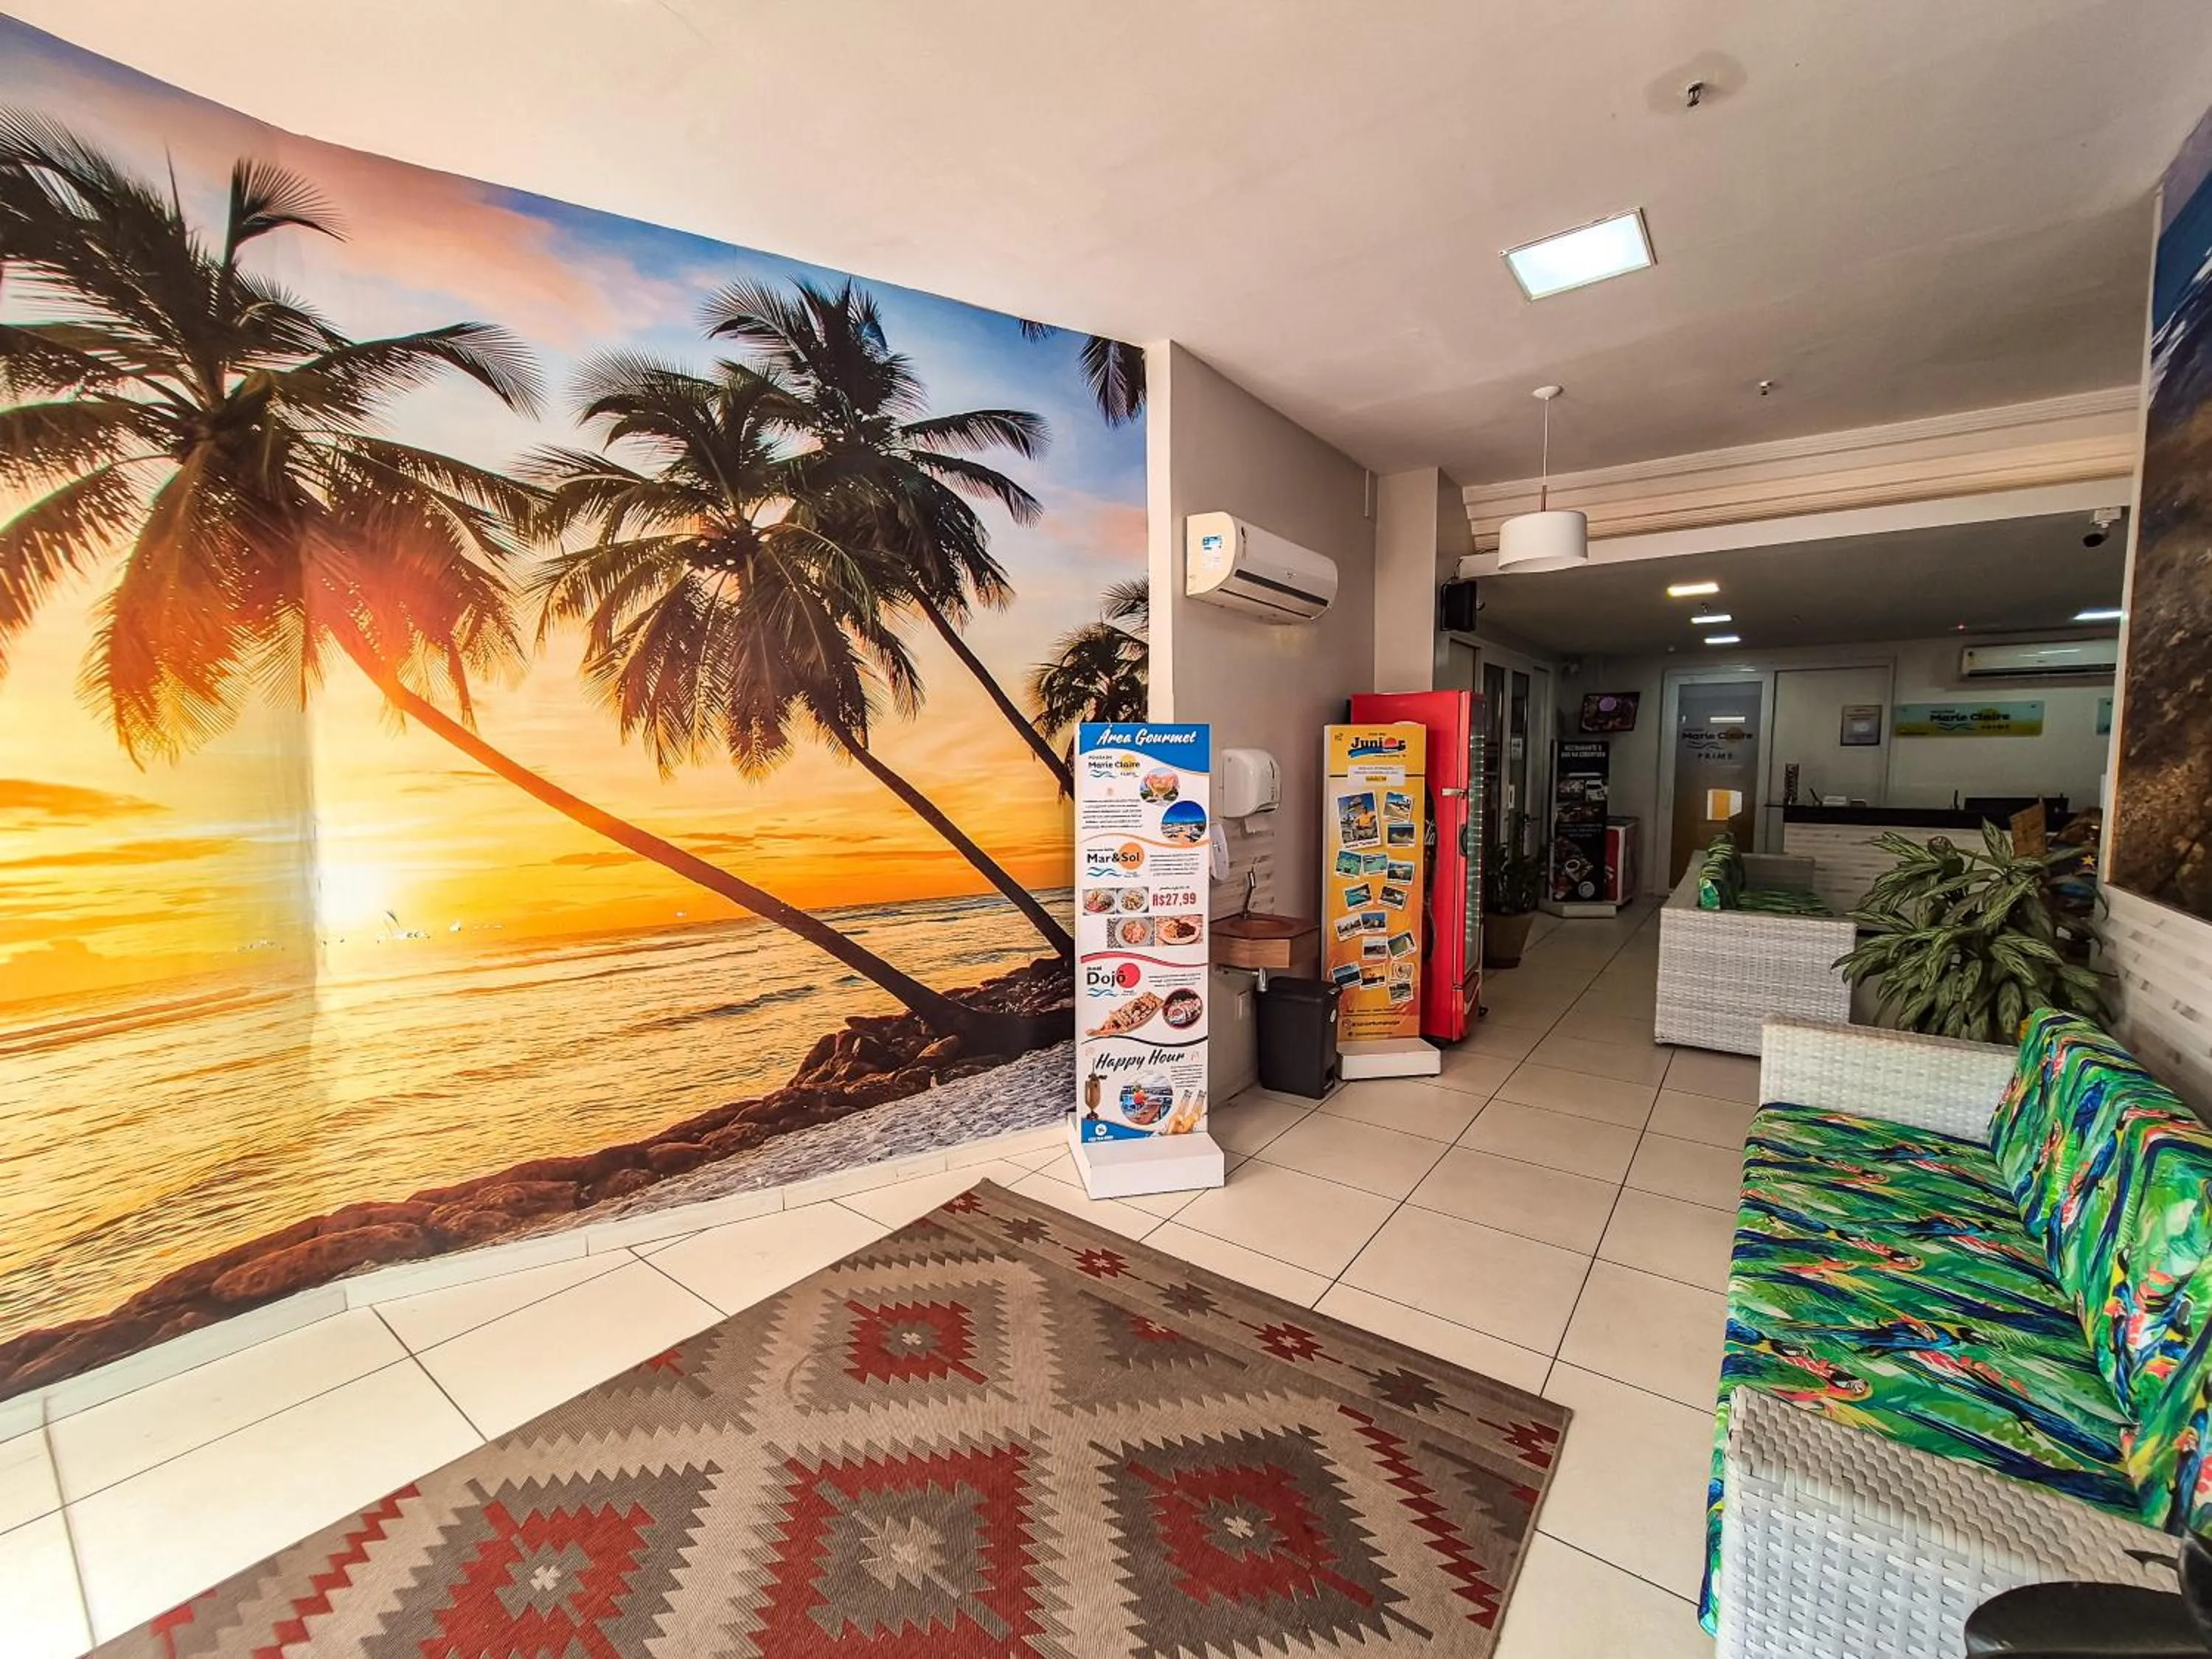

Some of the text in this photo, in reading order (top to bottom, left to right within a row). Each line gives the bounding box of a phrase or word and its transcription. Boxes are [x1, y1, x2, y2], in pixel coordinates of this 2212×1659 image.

[1930, 712, 2011, 722] Marie Claire
[1096, 724, 1197, 746] Área Gourmet
[1682, 731, 1715, 740] Marie
[1698, 752, 1733, 760] PRIME
[1088, 760, 1141, 769] Marie Claire
[1086, 852, 1140, 863] Mar&Sol
[1152, 891, 1197, 907] R$27,99
[1086, 970, 1127, 987] Dojô
[1095, 1048, 1186, 1072] Happy Hour
